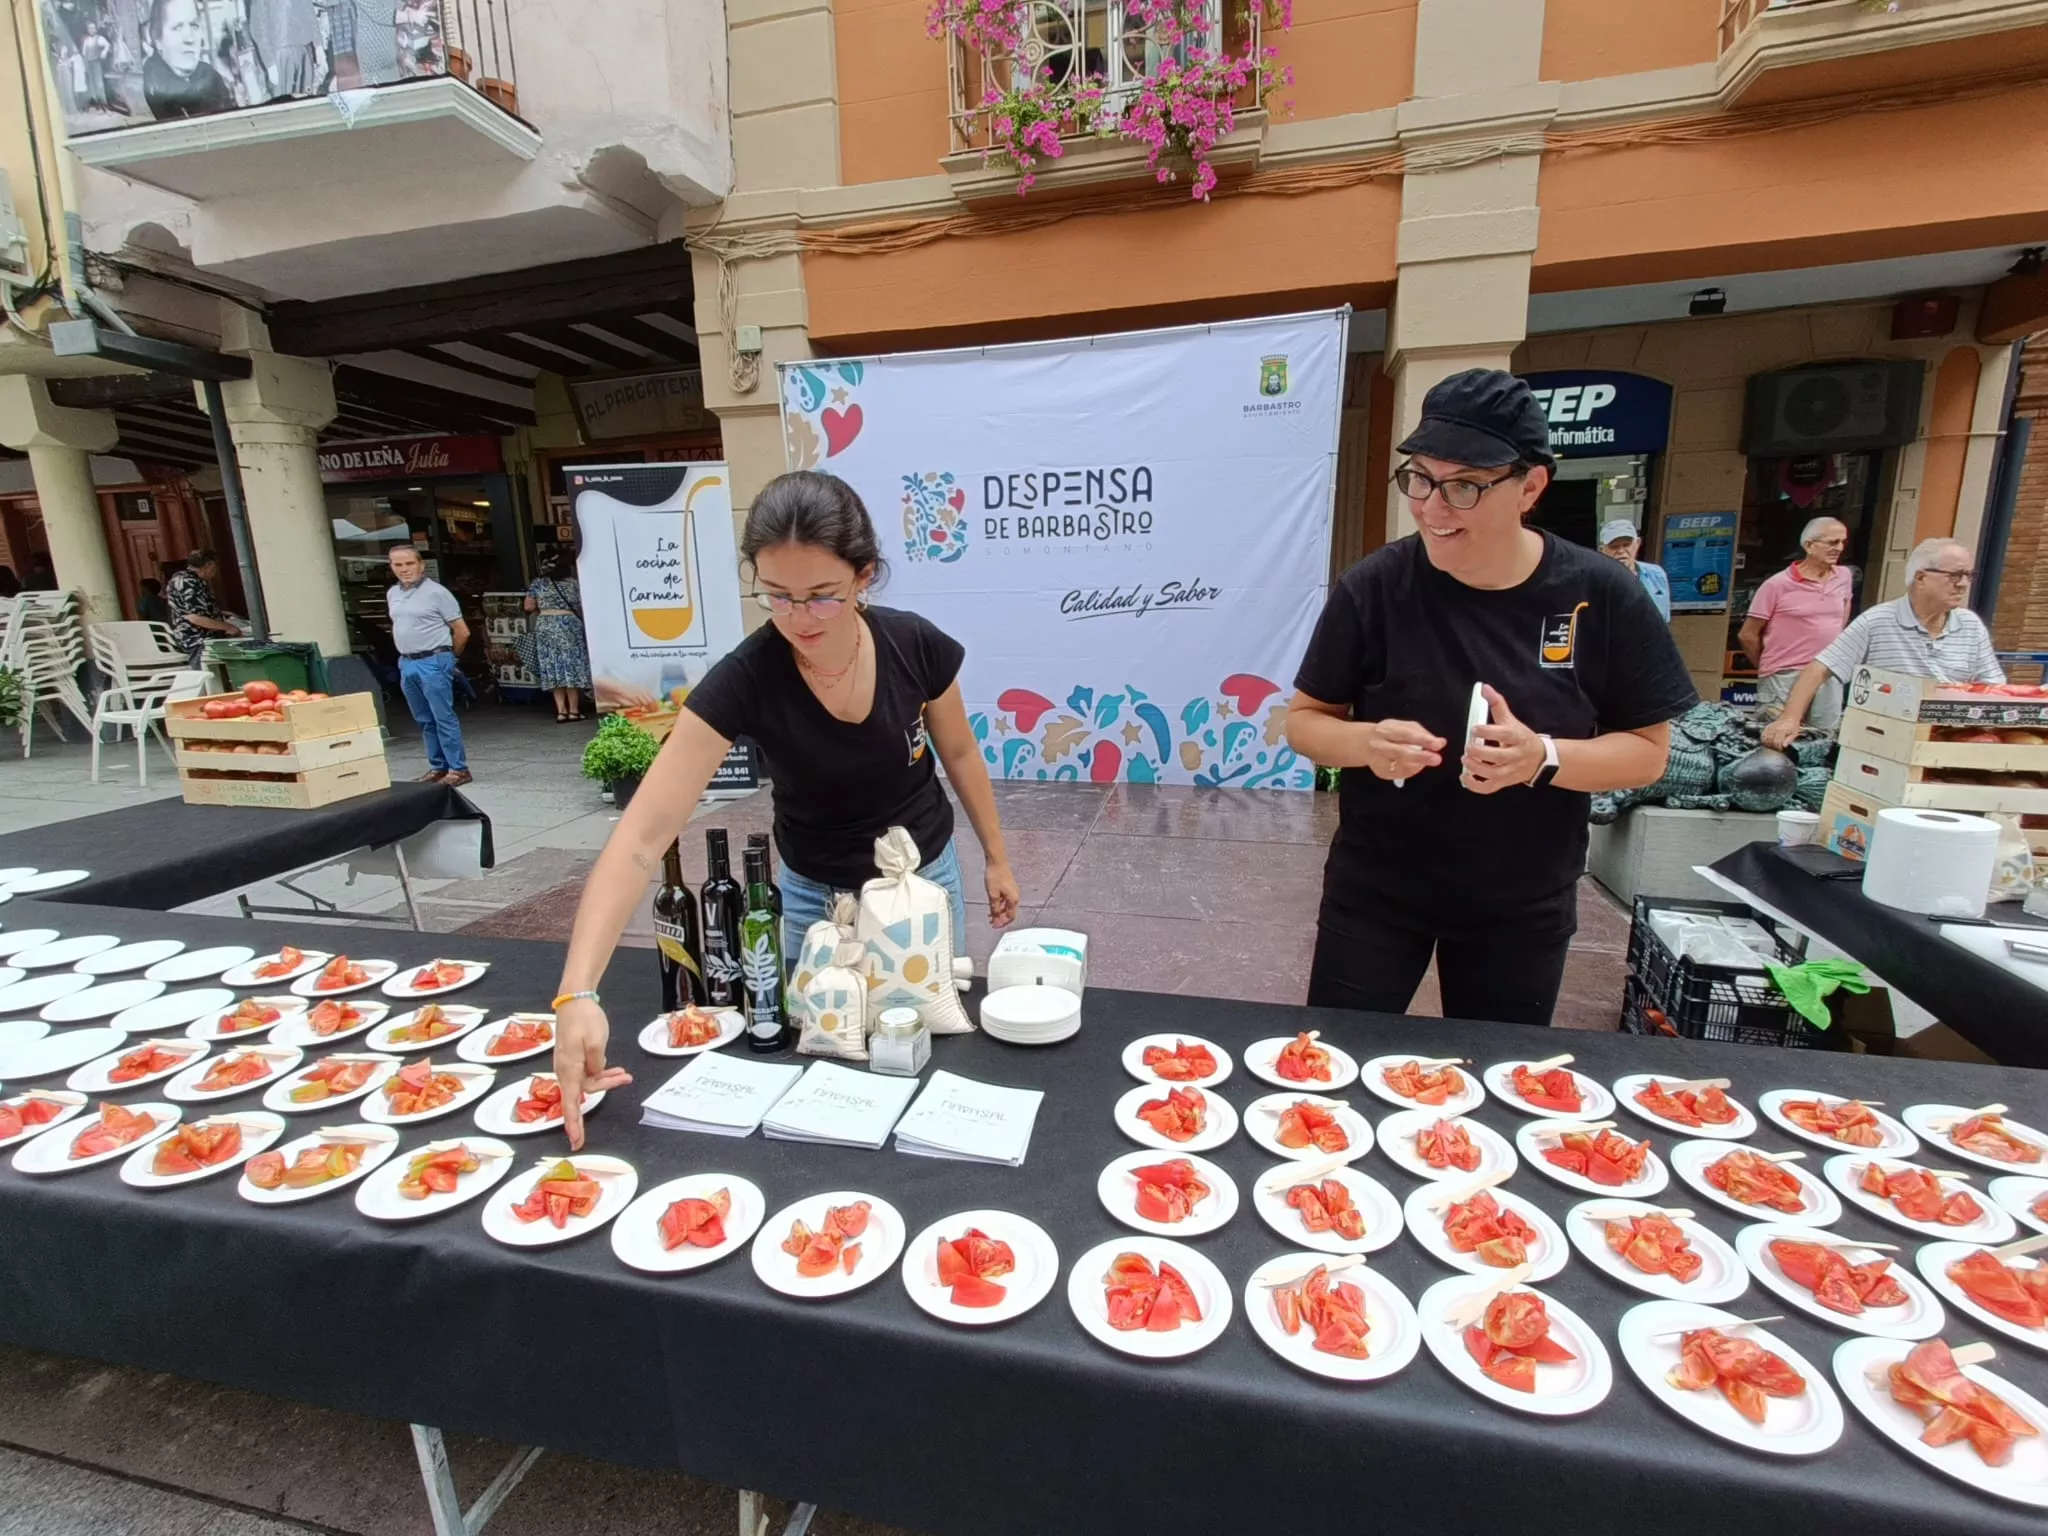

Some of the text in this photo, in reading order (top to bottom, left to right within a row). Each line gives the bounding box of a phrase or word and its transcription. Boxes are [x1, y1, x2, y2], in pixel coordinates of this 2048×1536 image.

[1243, 401, 1302, 413] BARBASTRO
[1531, 384, 1616, 422] EEP
[319, 454, 340, 470] NO
[342, 452, 364, 468] DE
[364, 445, 405, 467] LEÑA
[405, 442, 449, 474] Julia
[984, 466, 1153, 510] DESPENSA
[985, 503, 1153, 541] DE BARBASTRO
[1679, 516, 1722, 529] BEEP
[656, 537, 679, 552] La
[636, 554, 680, 569] cocina
[664, 572, 683, 589] de
[629, 587, 684, 603] Carmen
[1060, 577, 1223, 618] Calidad y Sabor
